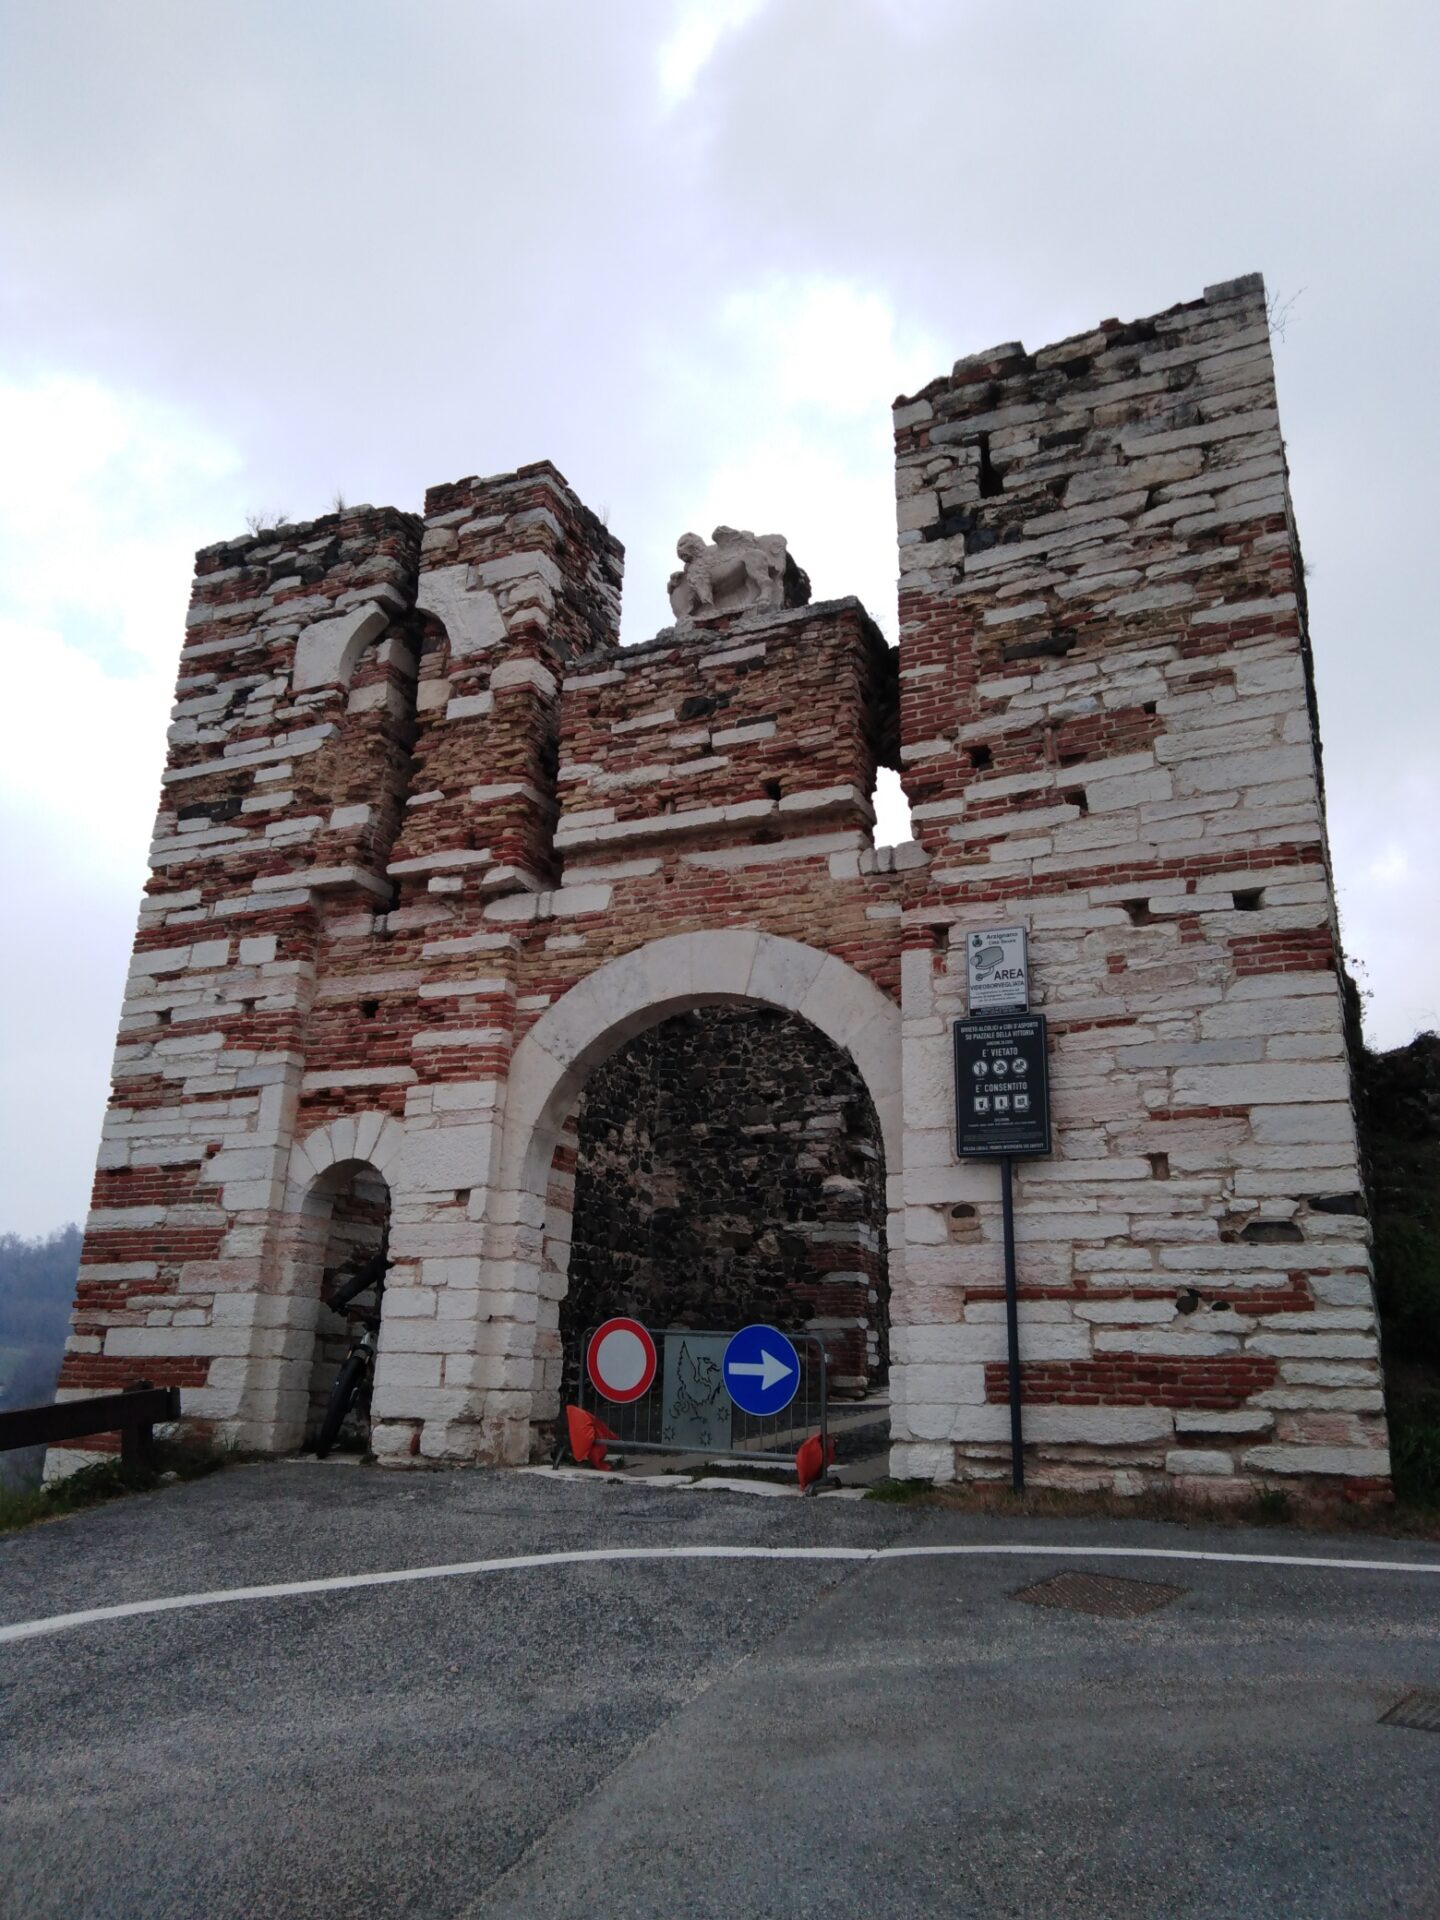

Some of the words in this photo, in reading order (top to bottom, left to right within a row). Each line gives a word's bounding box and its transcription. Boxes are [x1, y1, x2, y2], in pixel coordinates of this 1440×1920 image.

[994, 968, 1024, 980] AREA
[978, 1024, 999, 1032] ALCOLICI
[972, 1031, 995, 1040] PIAZZALE
[1012, 1029, 1035, 1037] VITTORIA
[990, 1047, 1018, 1057] VIETATO
[984, 1081, 1028, 1093] CONSENTITO
